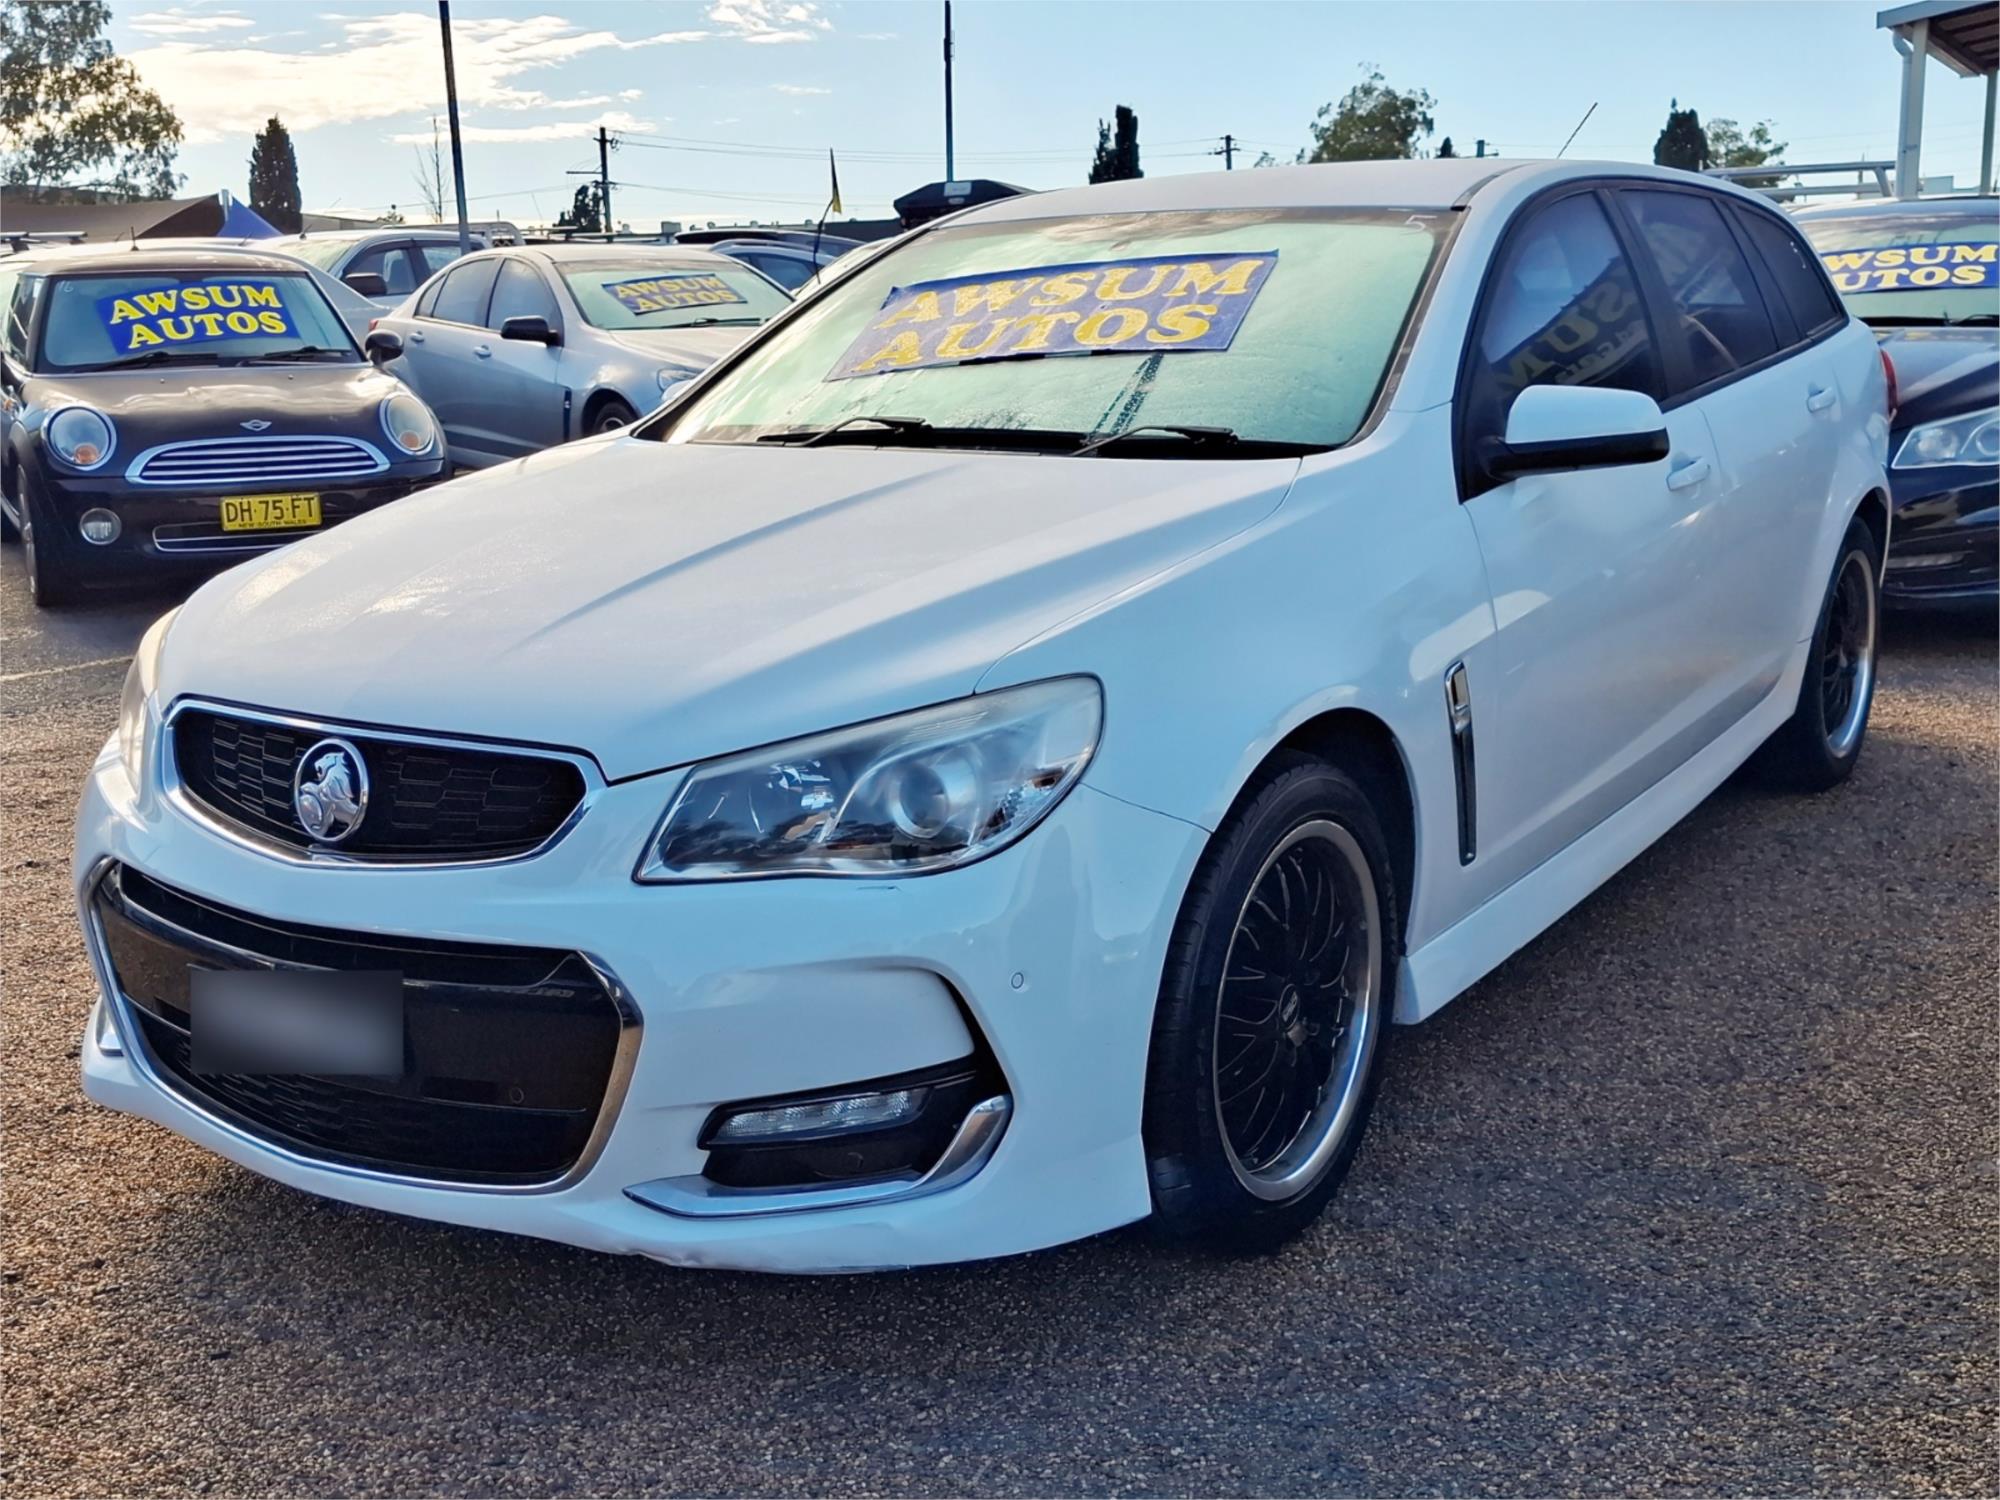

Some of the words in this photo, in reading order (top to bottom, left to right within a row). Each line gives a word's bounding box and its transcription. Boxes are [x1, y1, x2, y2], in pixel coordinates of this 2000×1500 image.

[1822, 244, 1998, 272] WSUM
[615, 276, 726, 299] AWSUM
[873, 259, 1265, 330] AWSUM
[1833, 265, 1986, 291] UTOS
[110, 285, 283, 325] AWSUM
[637, 290, 738, 311] AUTOS
[128, 311, 287, 349] AUTOS
[851, 304, 1218, 372] AUTOS
